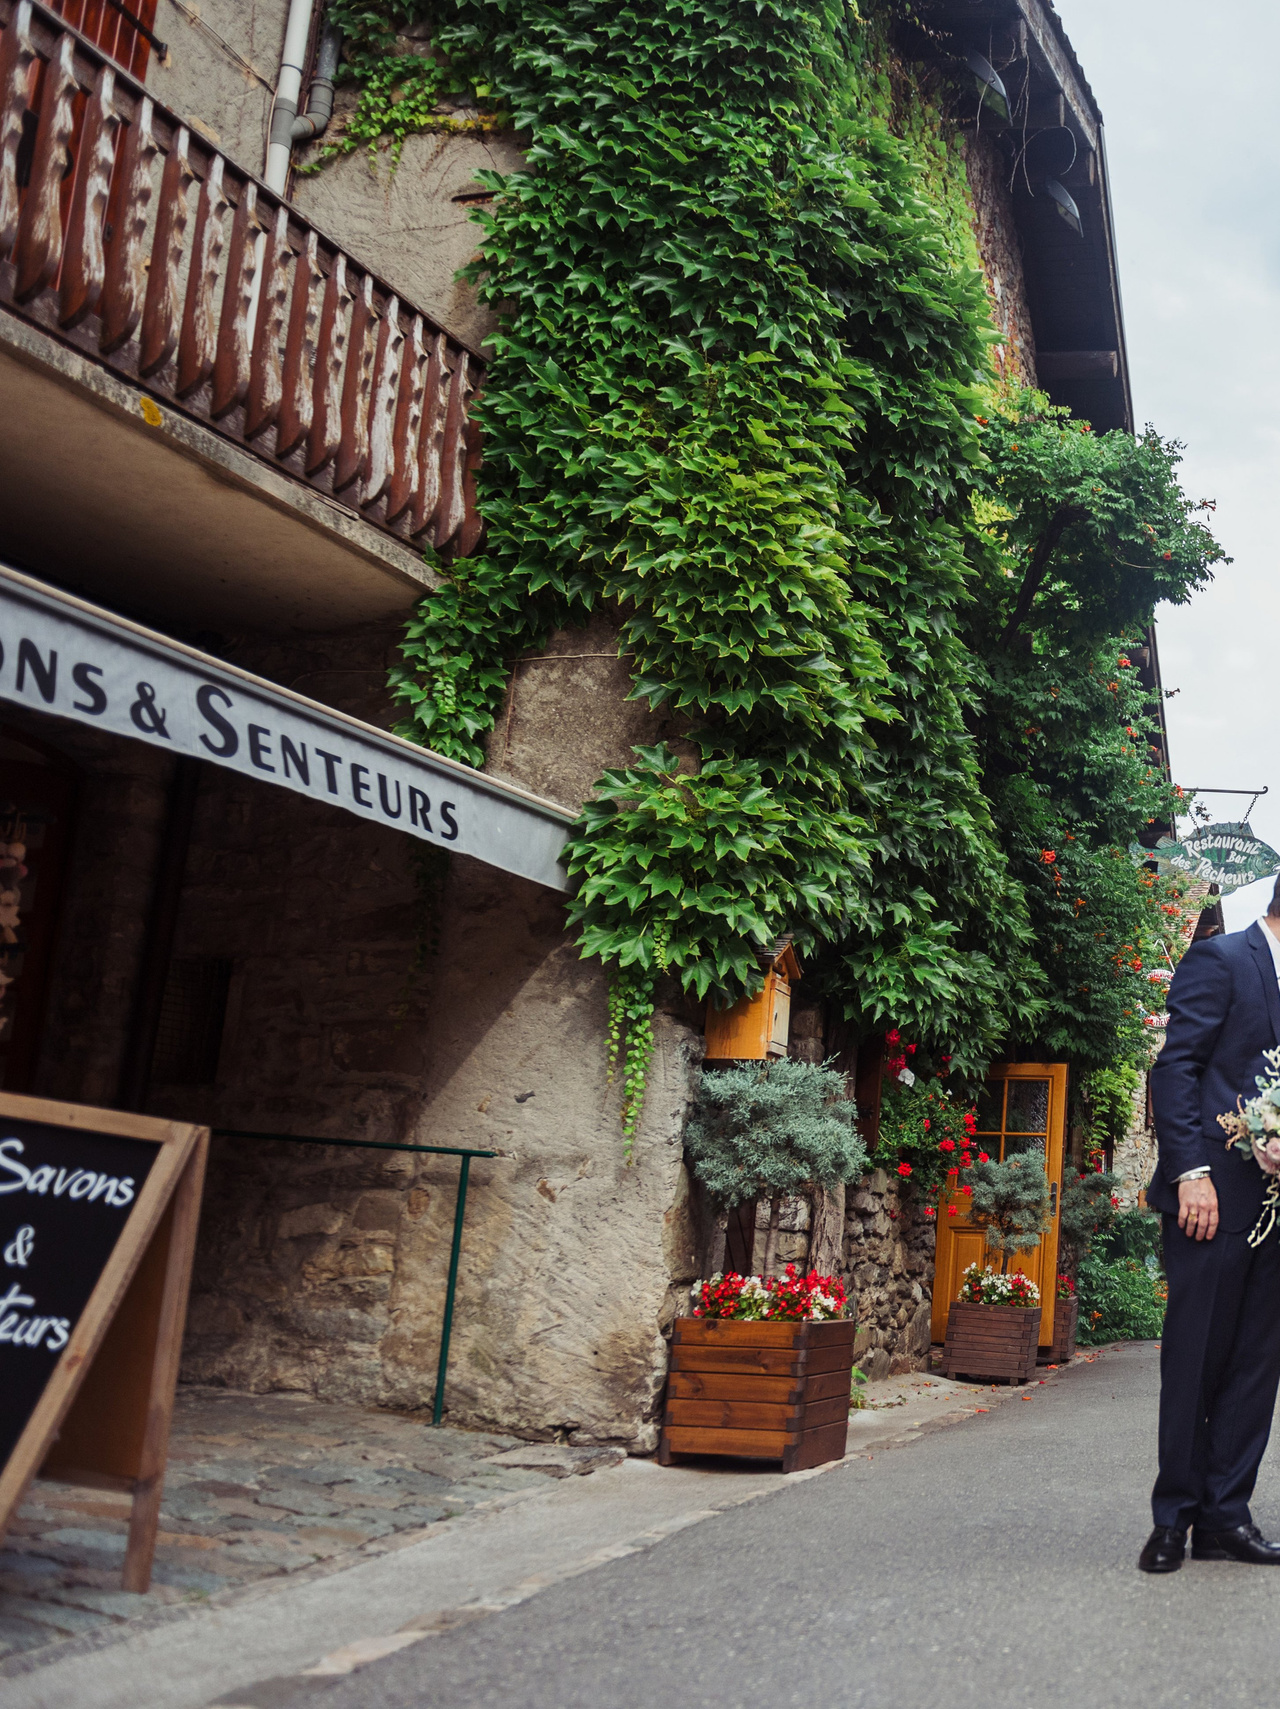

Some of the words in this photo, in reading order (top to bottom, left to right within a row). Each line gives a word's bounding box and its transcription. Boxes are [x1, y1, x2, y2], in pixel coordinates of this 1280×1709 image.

[0, 637, 108, 717] NS
[129, 681, 171, 740] &
[195, 684, 460, 842] SENTEURS
[1182, 834, 1263, 858] Restaurant
[1225, 850, 1248, 865] Bar
[1170, 853, 1192, 870] des
[1194, 856, 1256, 886] Pêcheurs
[0, 1137, 135, 1207] Savons
[4, 1224, 35, 1267] &
